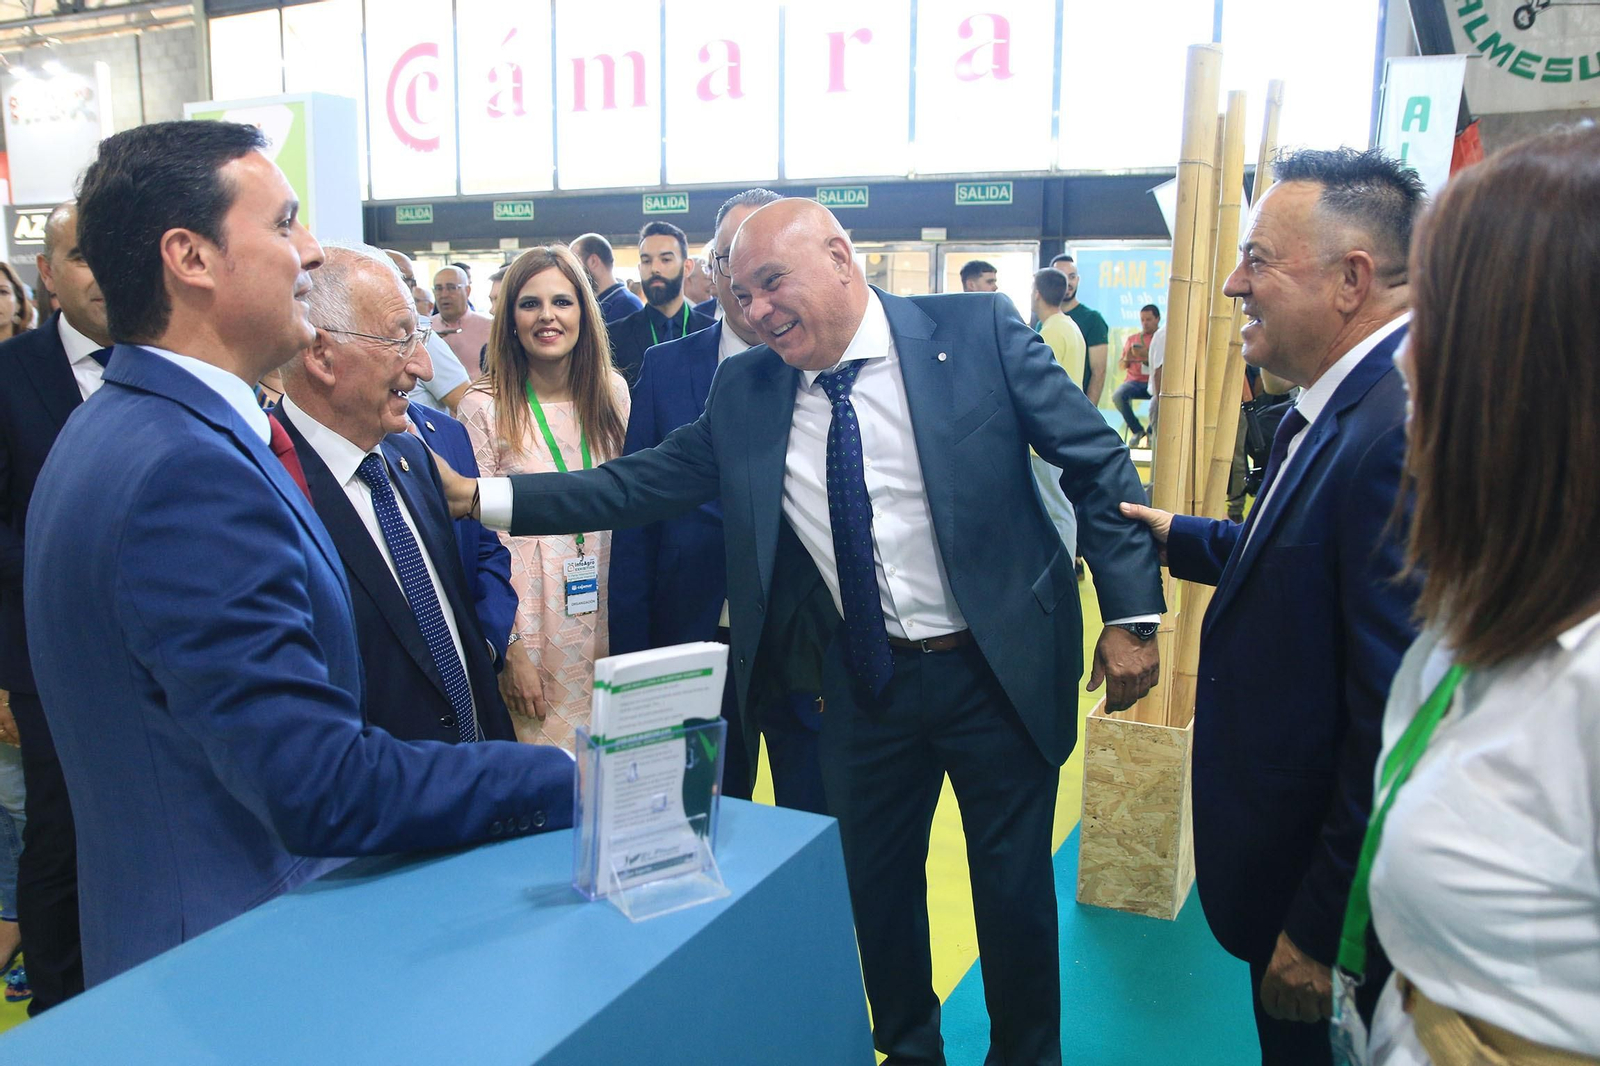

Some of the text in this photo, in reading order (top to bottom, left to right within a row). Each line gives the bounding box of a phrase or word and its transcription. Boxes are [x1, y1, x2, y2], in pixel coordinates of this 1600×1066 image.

[1401, 96, 1431, 172] AL
[820, 191, 865, 204] SALIDA
[958, 187, 1009, 200] SALIDA
[496, 203, 531, 217] SALIDA
[645, 196, 687, 210] SALIDA
[398, 207, 431, 221] SALIDA
[14, 214, 47, 239] AZ
